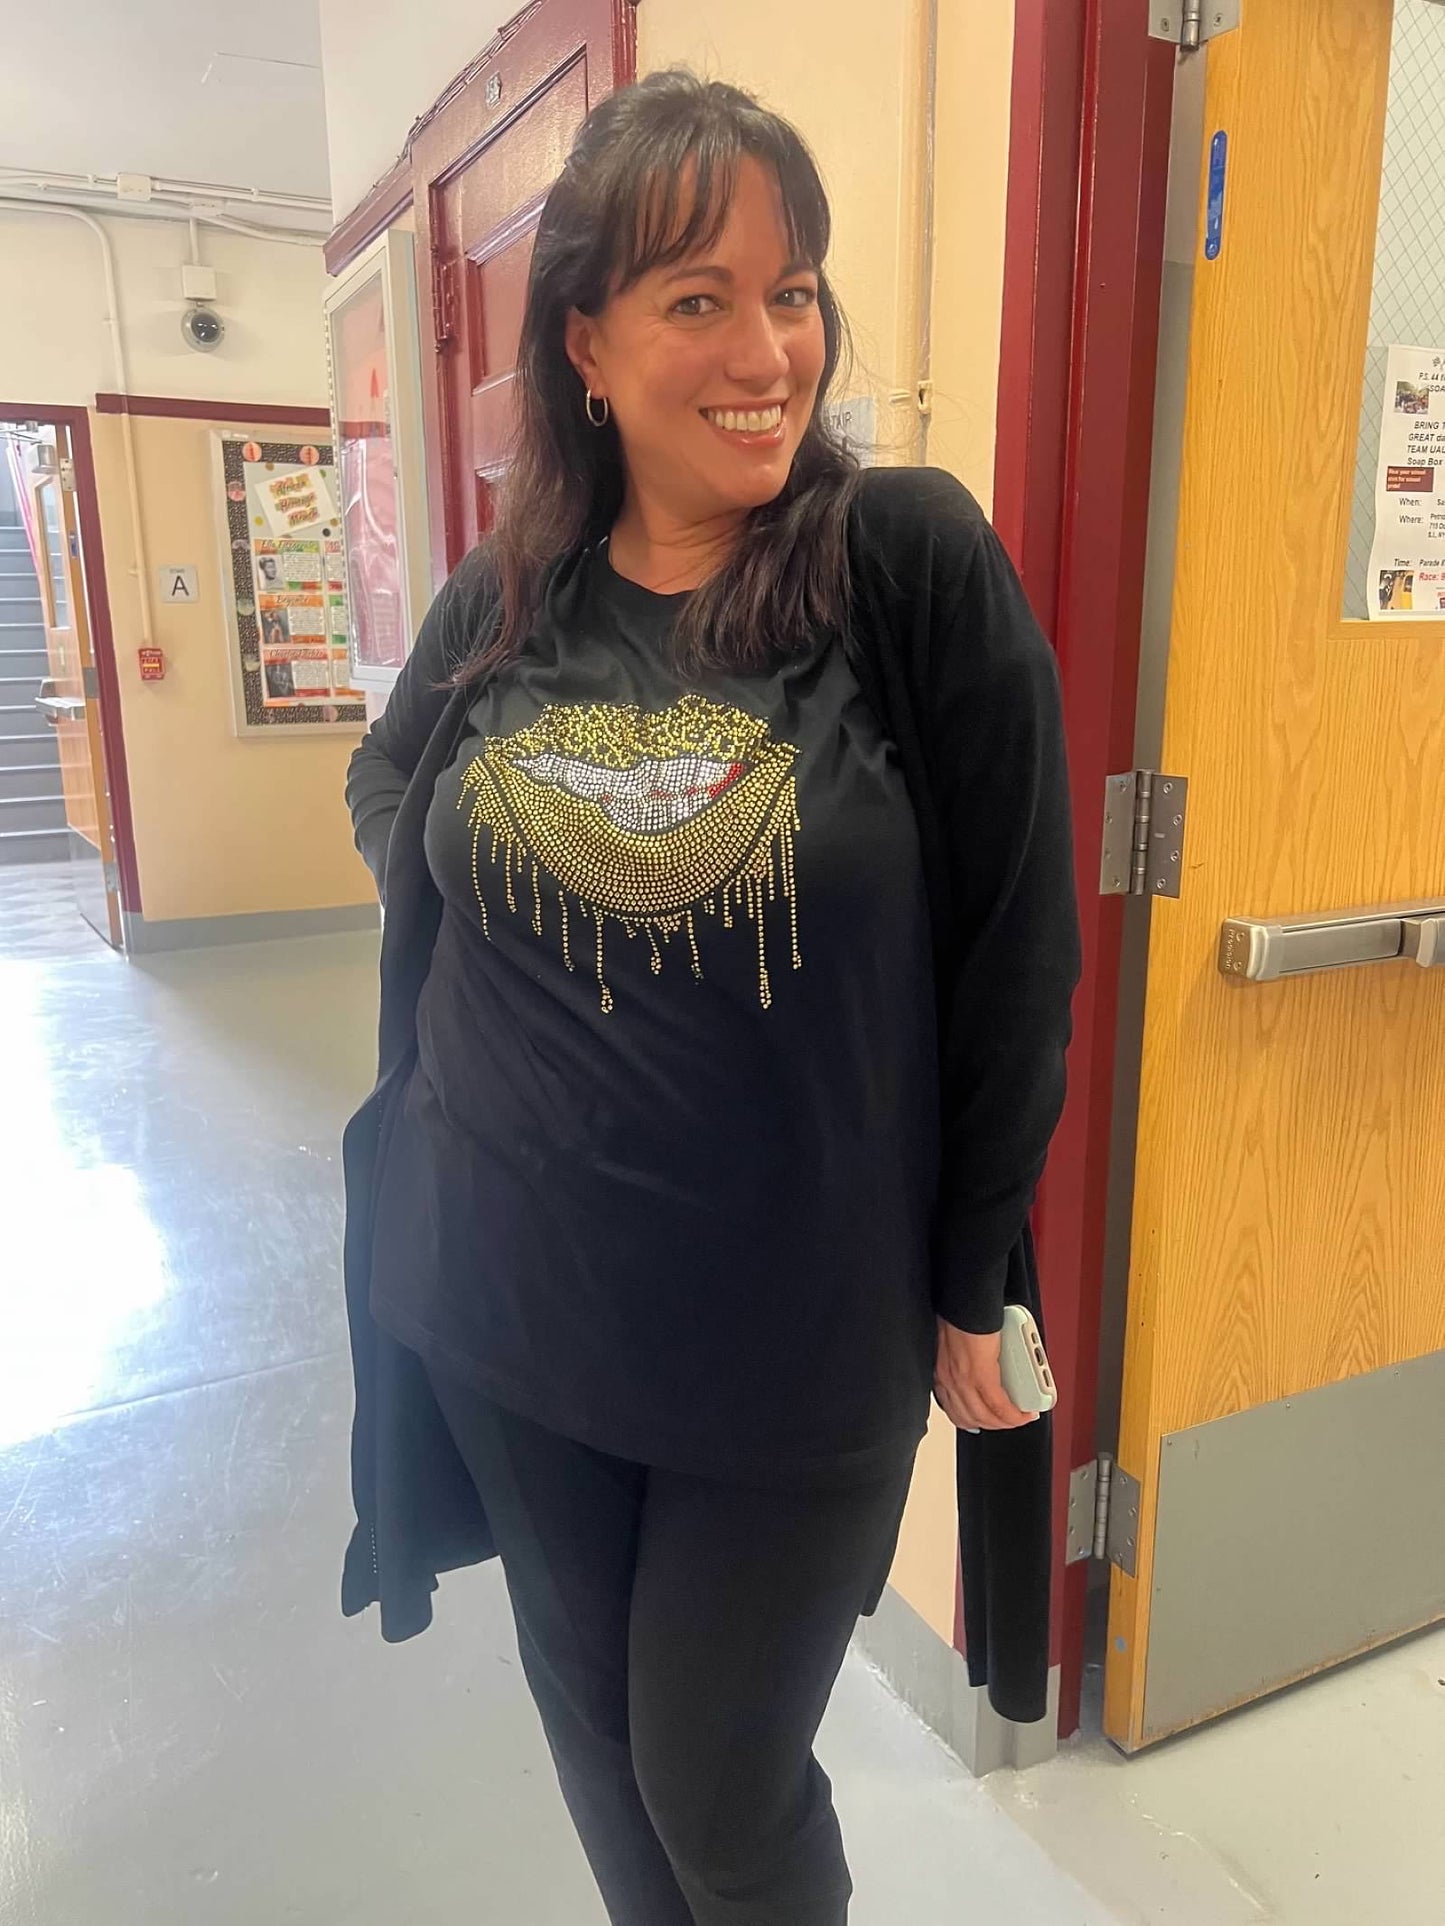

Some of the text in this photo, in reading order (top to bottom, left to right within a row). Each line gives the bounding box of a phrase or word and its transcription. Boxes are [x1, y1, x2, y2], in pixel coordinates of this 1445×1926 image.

[1414, 421, 1439, 430] BRING
[1408, 433, 1436, 442] GREAT
[1407, 445, 1428, 454] TEAM
[1407, 457, 1443, 467] Soap Box
[1399, 498, 1422, 506] When:
[1399, 514, 1424, 524] Where:
[1394, 558, 1412, 567] Time:
[1419, 572, 1439, 581] Race:
[171, 575, 190, 597] A
